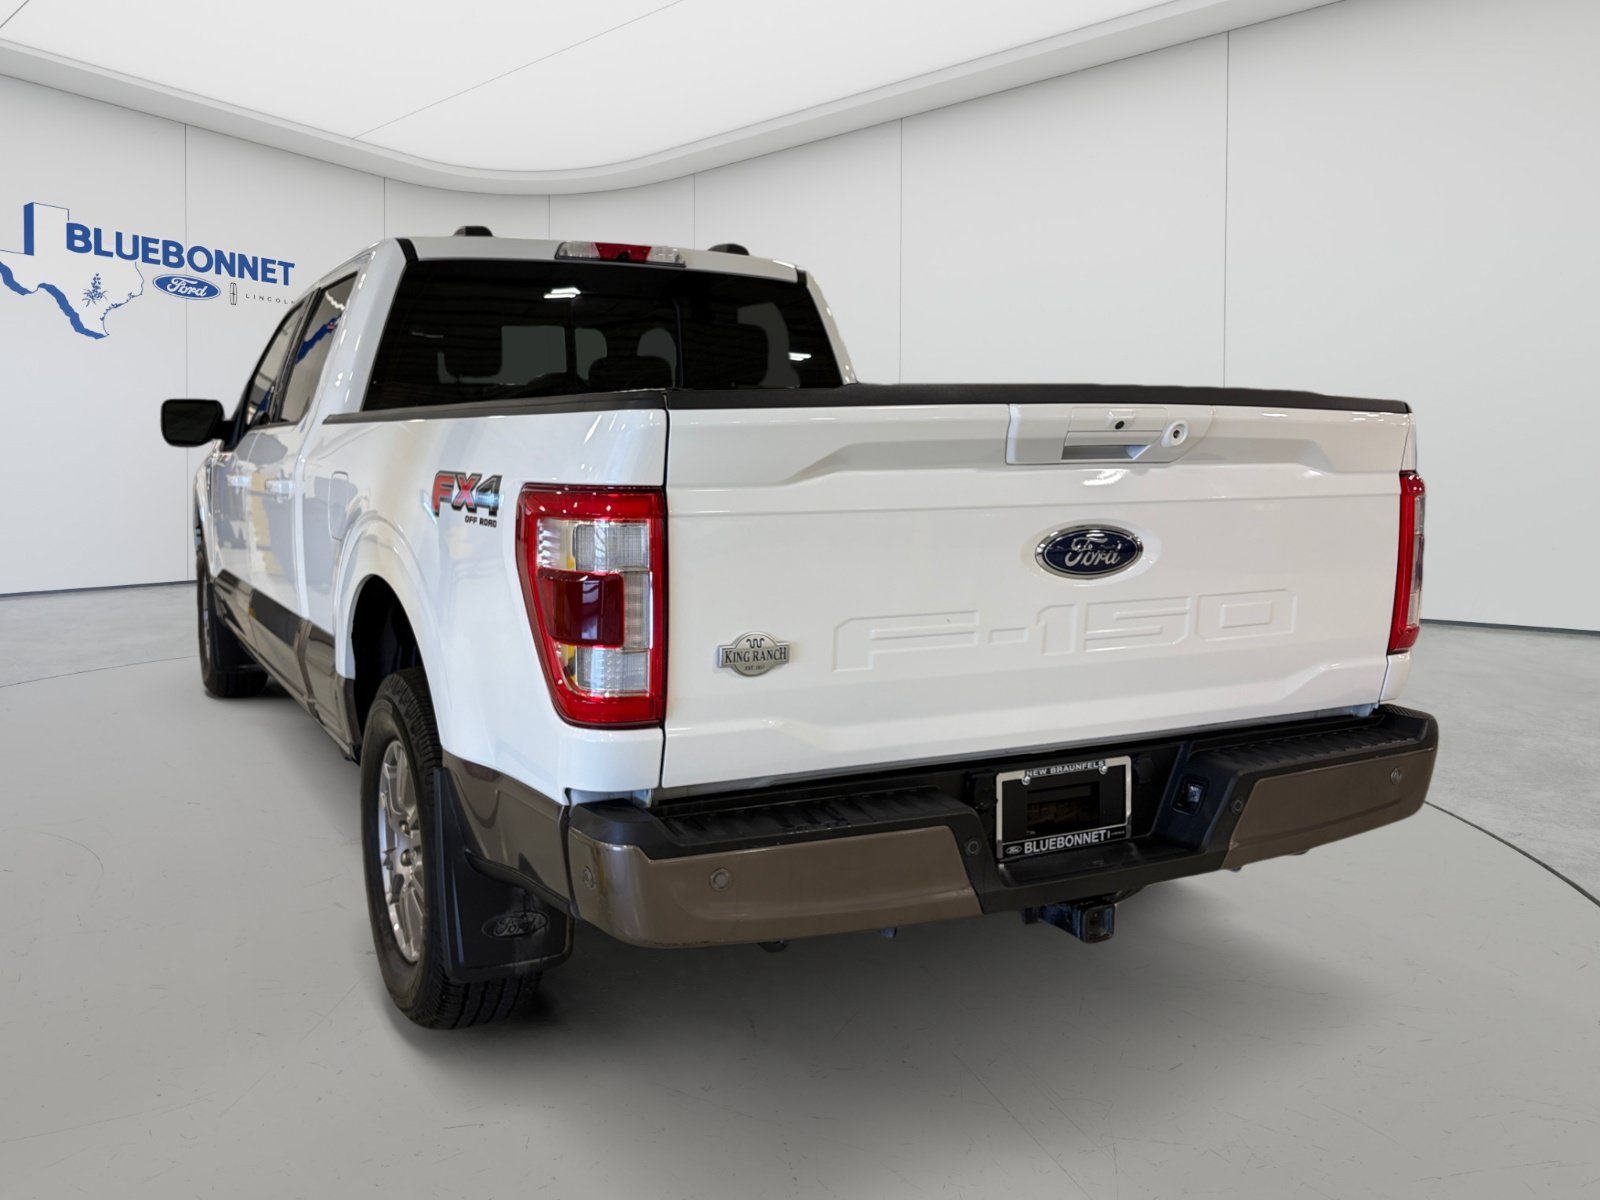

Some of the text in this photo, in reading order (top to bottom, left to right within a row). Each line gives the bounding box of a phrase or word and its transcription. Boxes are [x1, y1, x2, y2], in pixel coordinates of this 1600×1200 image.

[66, 222, 295, 286] BLUEBONNET
[166, 276, 208, 298] Ford
[432, 470, 503, 517] FX4
[464, 515, 497, 528] OFF ROAD
[1064, 534, 1123, 568] Ford
[832, 589, 1297, 672] F-150
[724, 646, 787, 664] KING RANCH
[1026, 761, 1106, 778] NEW BRAUNFELS
[1023, 829, 1107, 854] BLUEBONNET
